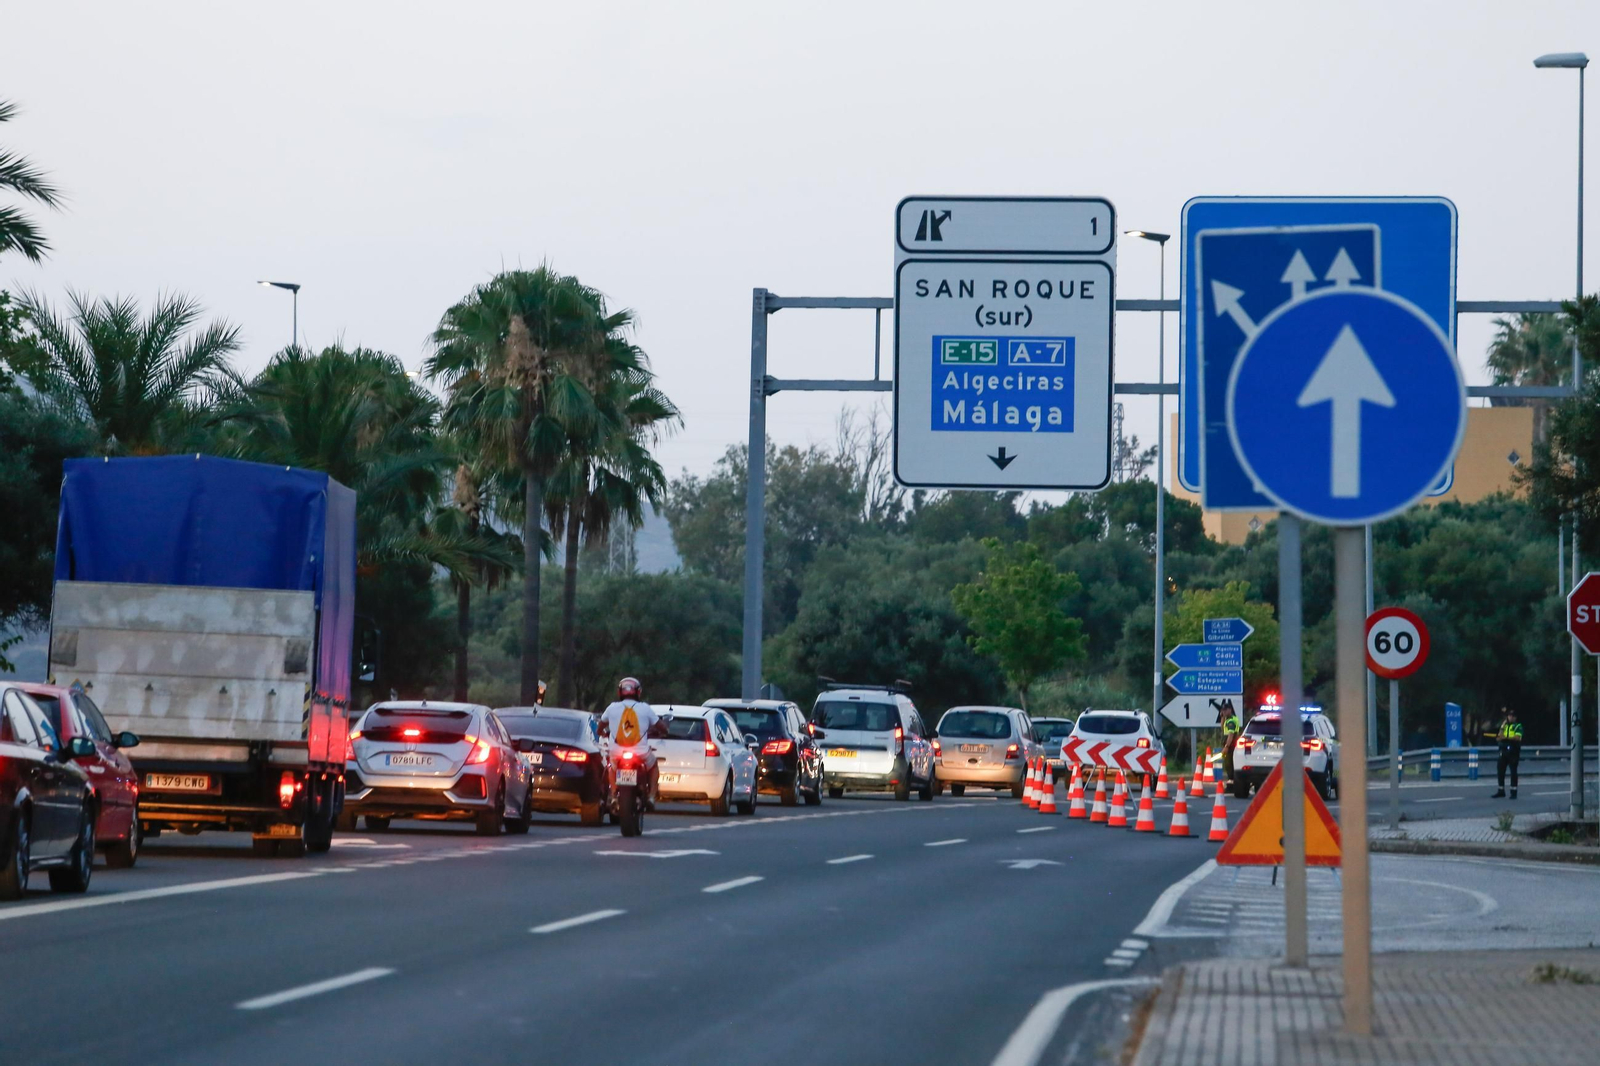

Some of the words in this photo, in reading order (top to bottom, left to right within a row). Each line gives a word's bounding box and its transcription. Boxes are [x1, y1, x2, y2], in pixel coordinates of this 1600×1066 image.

[1090, 217, 1098, 236] 1
[915, 279, 975, 298] SAN
[992, 280, 1095, 300] ROQUE
[975, 305, 1032, 328] (sur)
[944, 342, 994, 362] E-15
[1013, 343, 1062, 362] A-7
[942, 371, 1064, 396] Algeciras
[942, 399, 1062, 432] Málaga
[1374, 630, 1414, 654] 60
[1184, 702, 1190, 720] 1
[392, 756, 414, 764] 0789
[416, 757, 432, 765] LFC
[155, 775, 181, 786] 1379
[184, 776, 205, 787] CWG
